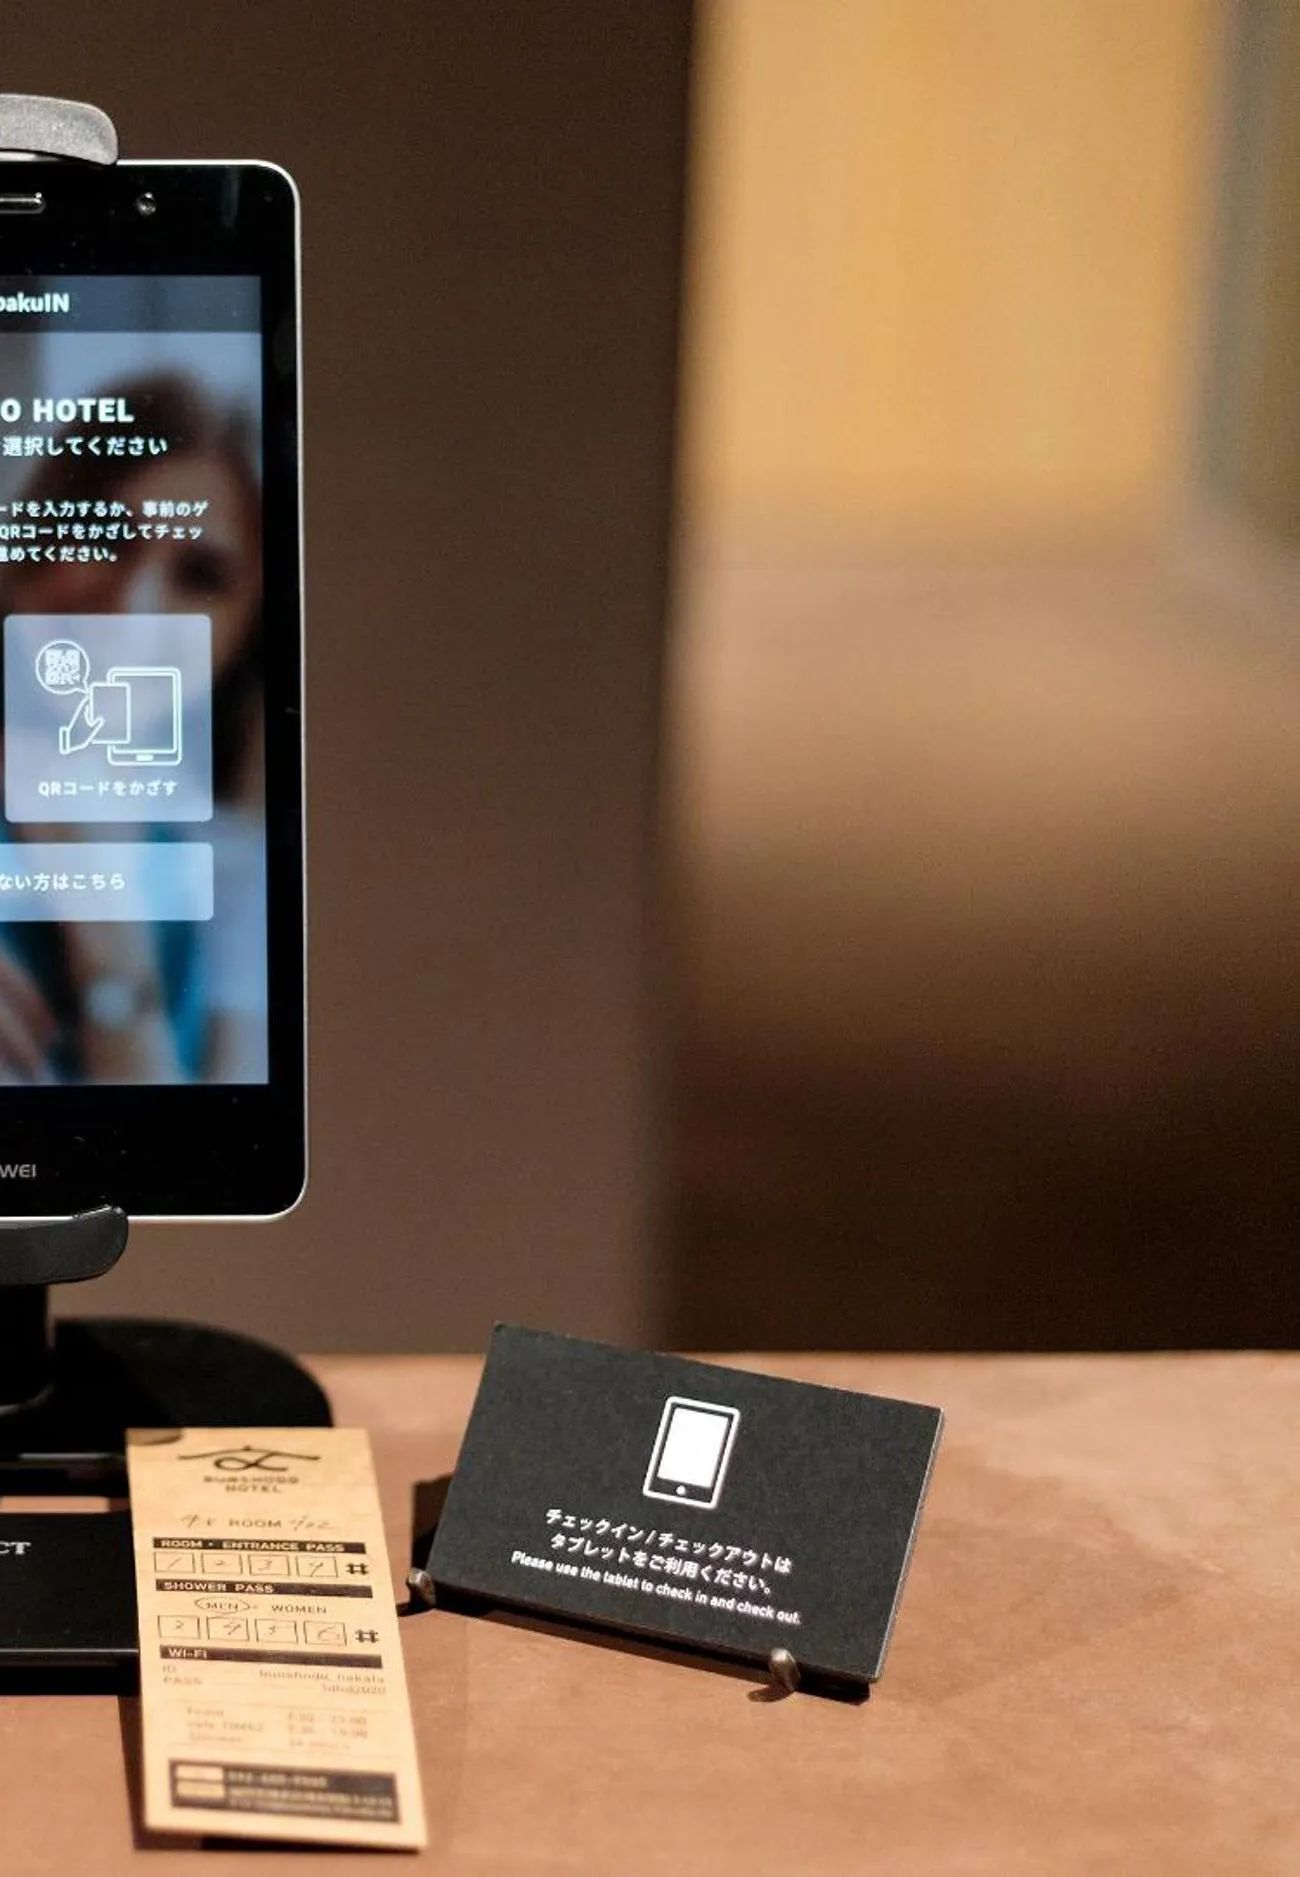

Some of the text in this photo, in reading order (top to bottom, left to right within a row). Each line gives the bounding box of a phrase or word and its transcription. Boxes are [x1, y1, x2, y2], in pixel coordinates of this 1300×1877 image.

[33, 399, 134, 423] HOTEL
[37, 780, 179, 798] QRコードをかざす
[225, 1484, 283, 1493] HOTEL
[228, 1518, 283, 1528] ROOM
[160, 1538, 345, 1553] ROOM ENTRANCE PASS
[550, 1533, 771, 1594] タブレットをご利用ください。
[163, 1581, 274, 1593] SHOWER PASS
[511, 1550, 802, 1626] Please use the tablet to check in and check out.
[271, 1604, 328, 1614] WOMEN
